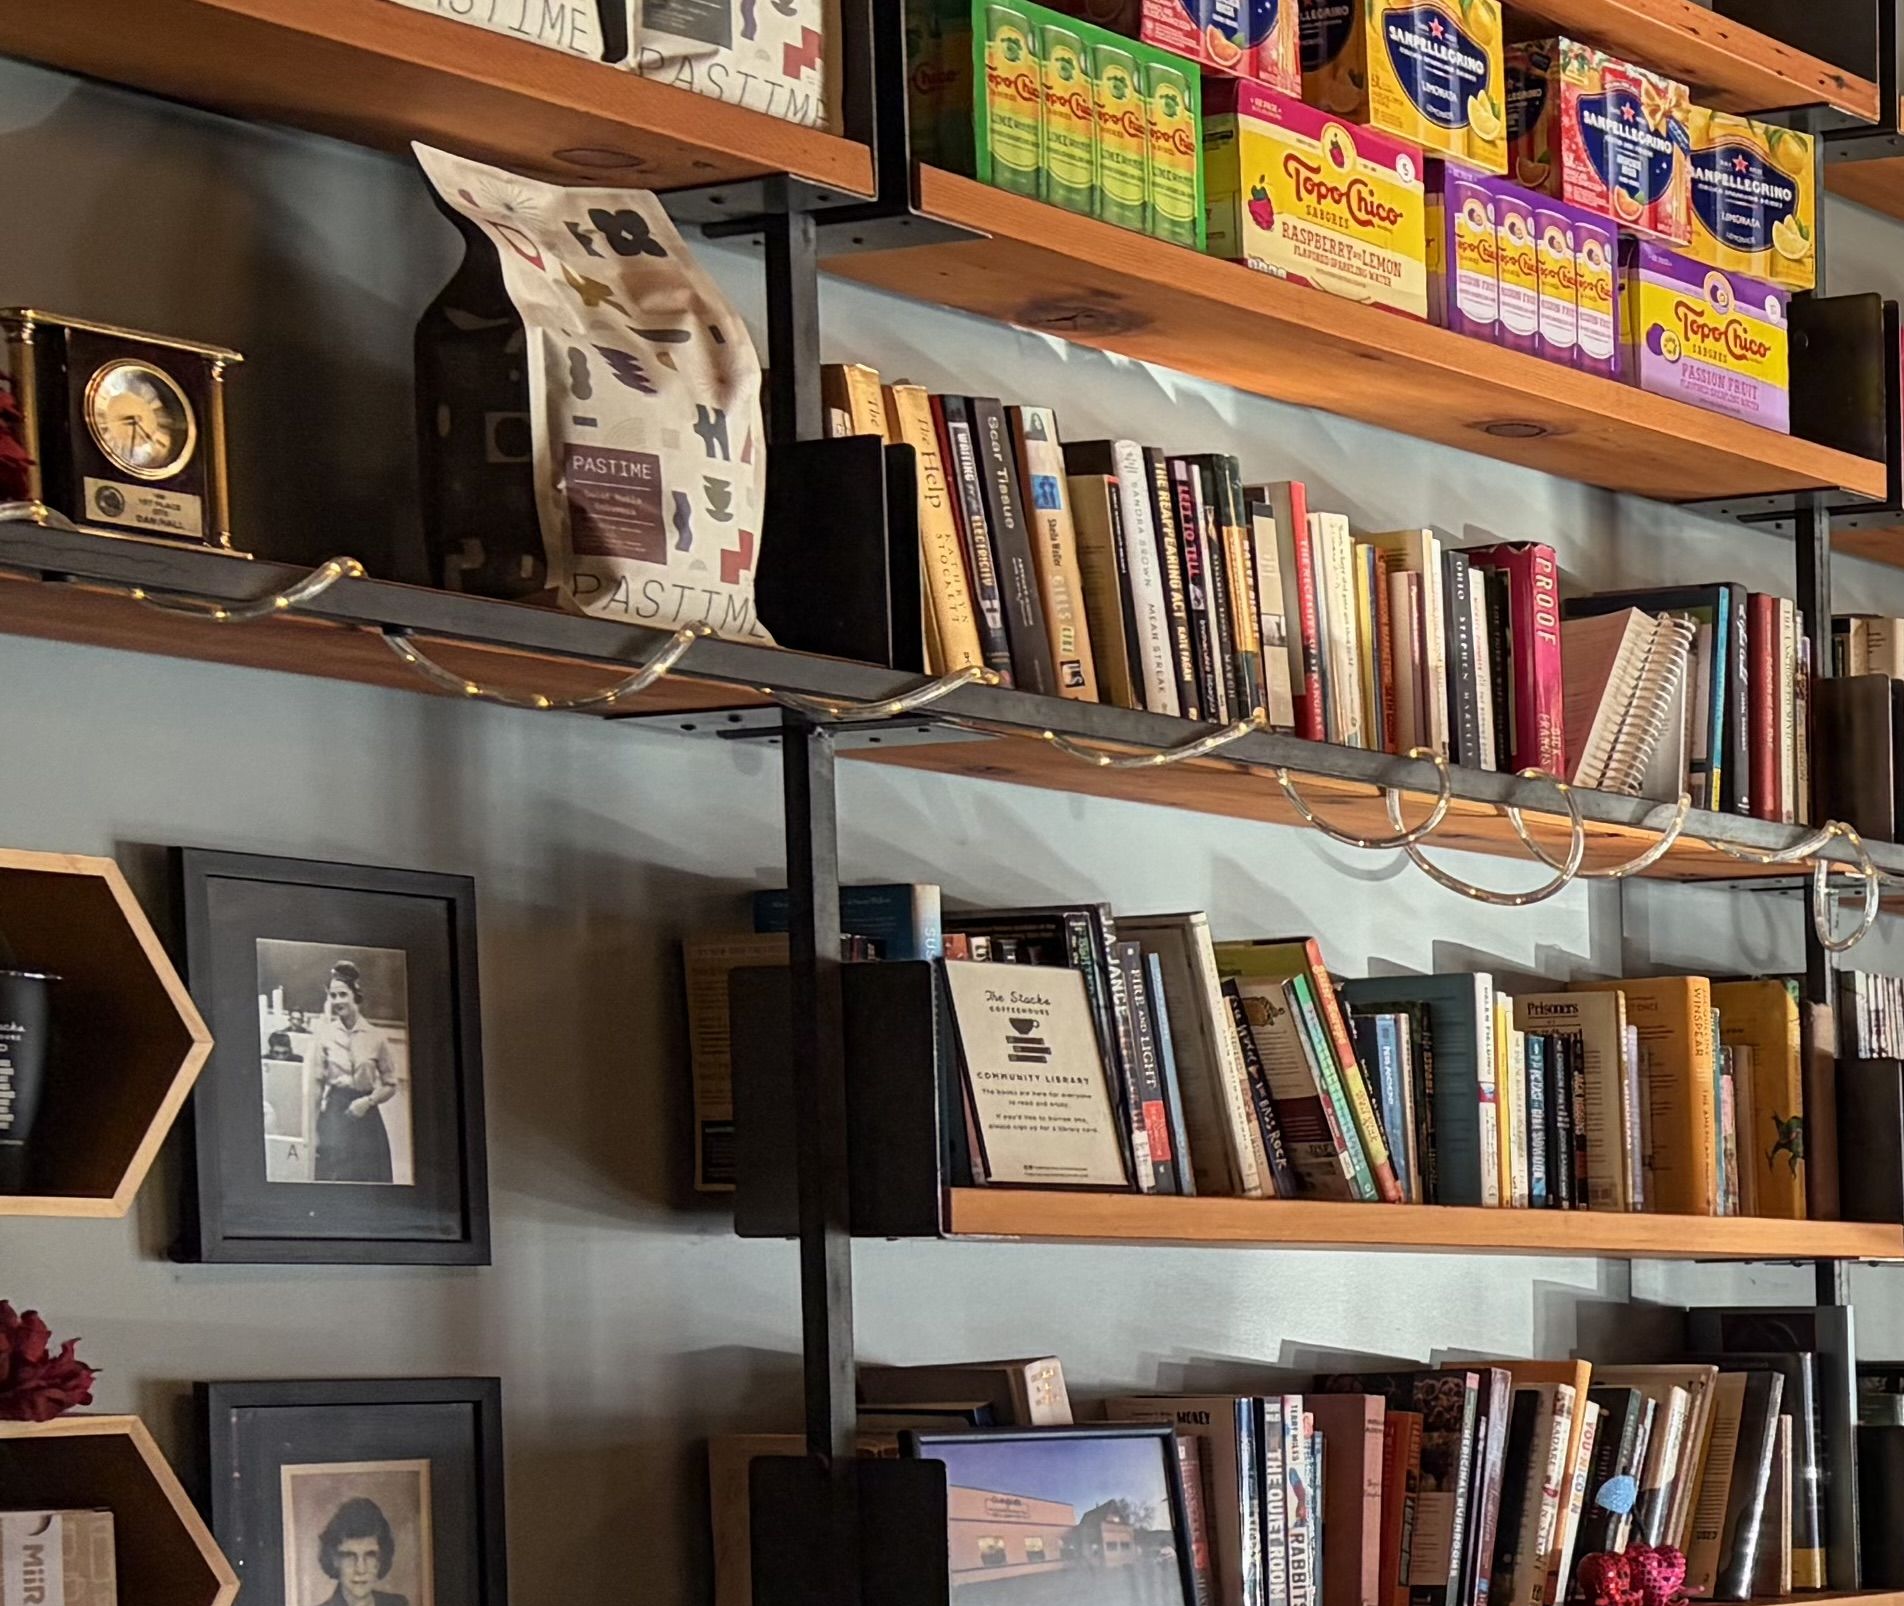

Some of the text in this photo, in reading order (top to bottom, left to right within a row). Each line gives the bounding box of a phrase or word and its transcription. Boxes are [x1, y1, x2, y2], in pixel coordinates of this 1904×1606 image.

[1389, 26, 1484, 75] SANPELLEGRINO
[1583, 110, 1672, 154] SANPELLEGRINO
[1283, 153, 1403, 228] Topo Chico
[1306, 205, 1349, 229] SABORES
[1282, 221, 1402, 277] RASPBERRY LEMON
[1294, 245, 1392, 287] FLAVORED SPARKLING WATER
[1675, 300, 1771, 360] Topo Chico
[1682, 363, 1758, 399] PASSION FRUIT
[572, 455, 652, 480] PASTIME
[918, 415, 943, 508] The Help
[986, 415, 1016, 529] Scar Tissue
[957, 433, 976, 482] WAITING
[972, 515, 993, 586] ELECTRICITY
[1130, 481, 1153, 587] SANDRA BROWN
[1180, 485, 1199, 578] LEFT TO TELL
[1154, 462, 1185, 617] THE REAPPEARING ACT
[1299, 540, 1310, 562] THE
[935, 533, 958, 624] STOCKETT
[945, 533, 969, 624] KATHRYN
[1455, 561, 1465, 601] OHIO
[1535, 557, 1556, 645] PROOF
[1063, 664, 1083, 686] US
[1147, 603, 1166, 694] MEAN STREAK
[1177, 626, 1193, 681] KATE FAGAN
[1309, 640, 1318, 655] OF
[1459, 616, 1470, 681] STEPHEN
[1224, 654, 1236, 699] MARCH
[1310, 659, 1324, 735] STRANGERS
[1539, 713, 1551, 765] FRANCIS
[1551, 726, 1561, 755] DICK
[925, 927, 937, 959] SUS
[985, 990, 1051, 1006] The Stacks
[989, 1005, 1050, 1016] COFFEEHOUSE
[1527, 1001, 1579, 1016] Prisoners
[1694, 986, 1704, 1057] WINSPEAR
[1131, 969, 1158, 1088] FIRE AND LIGHT
[977, 1071, 1090, 1085] COMMUNITY LIBRARY
[287, 1144, 299, 1161] A
[1177, 1410, 1210, 1425] MONEY
[1290, 1404, 1300, 1462] TERRY MILES
[1267, 1449, 1286, 1599] THE QUIET ROOM
[1450, 1429, 1471, 1577] MEDICINAL MUSHROOMS
[22, 1544, 45, 1605] MiiR
